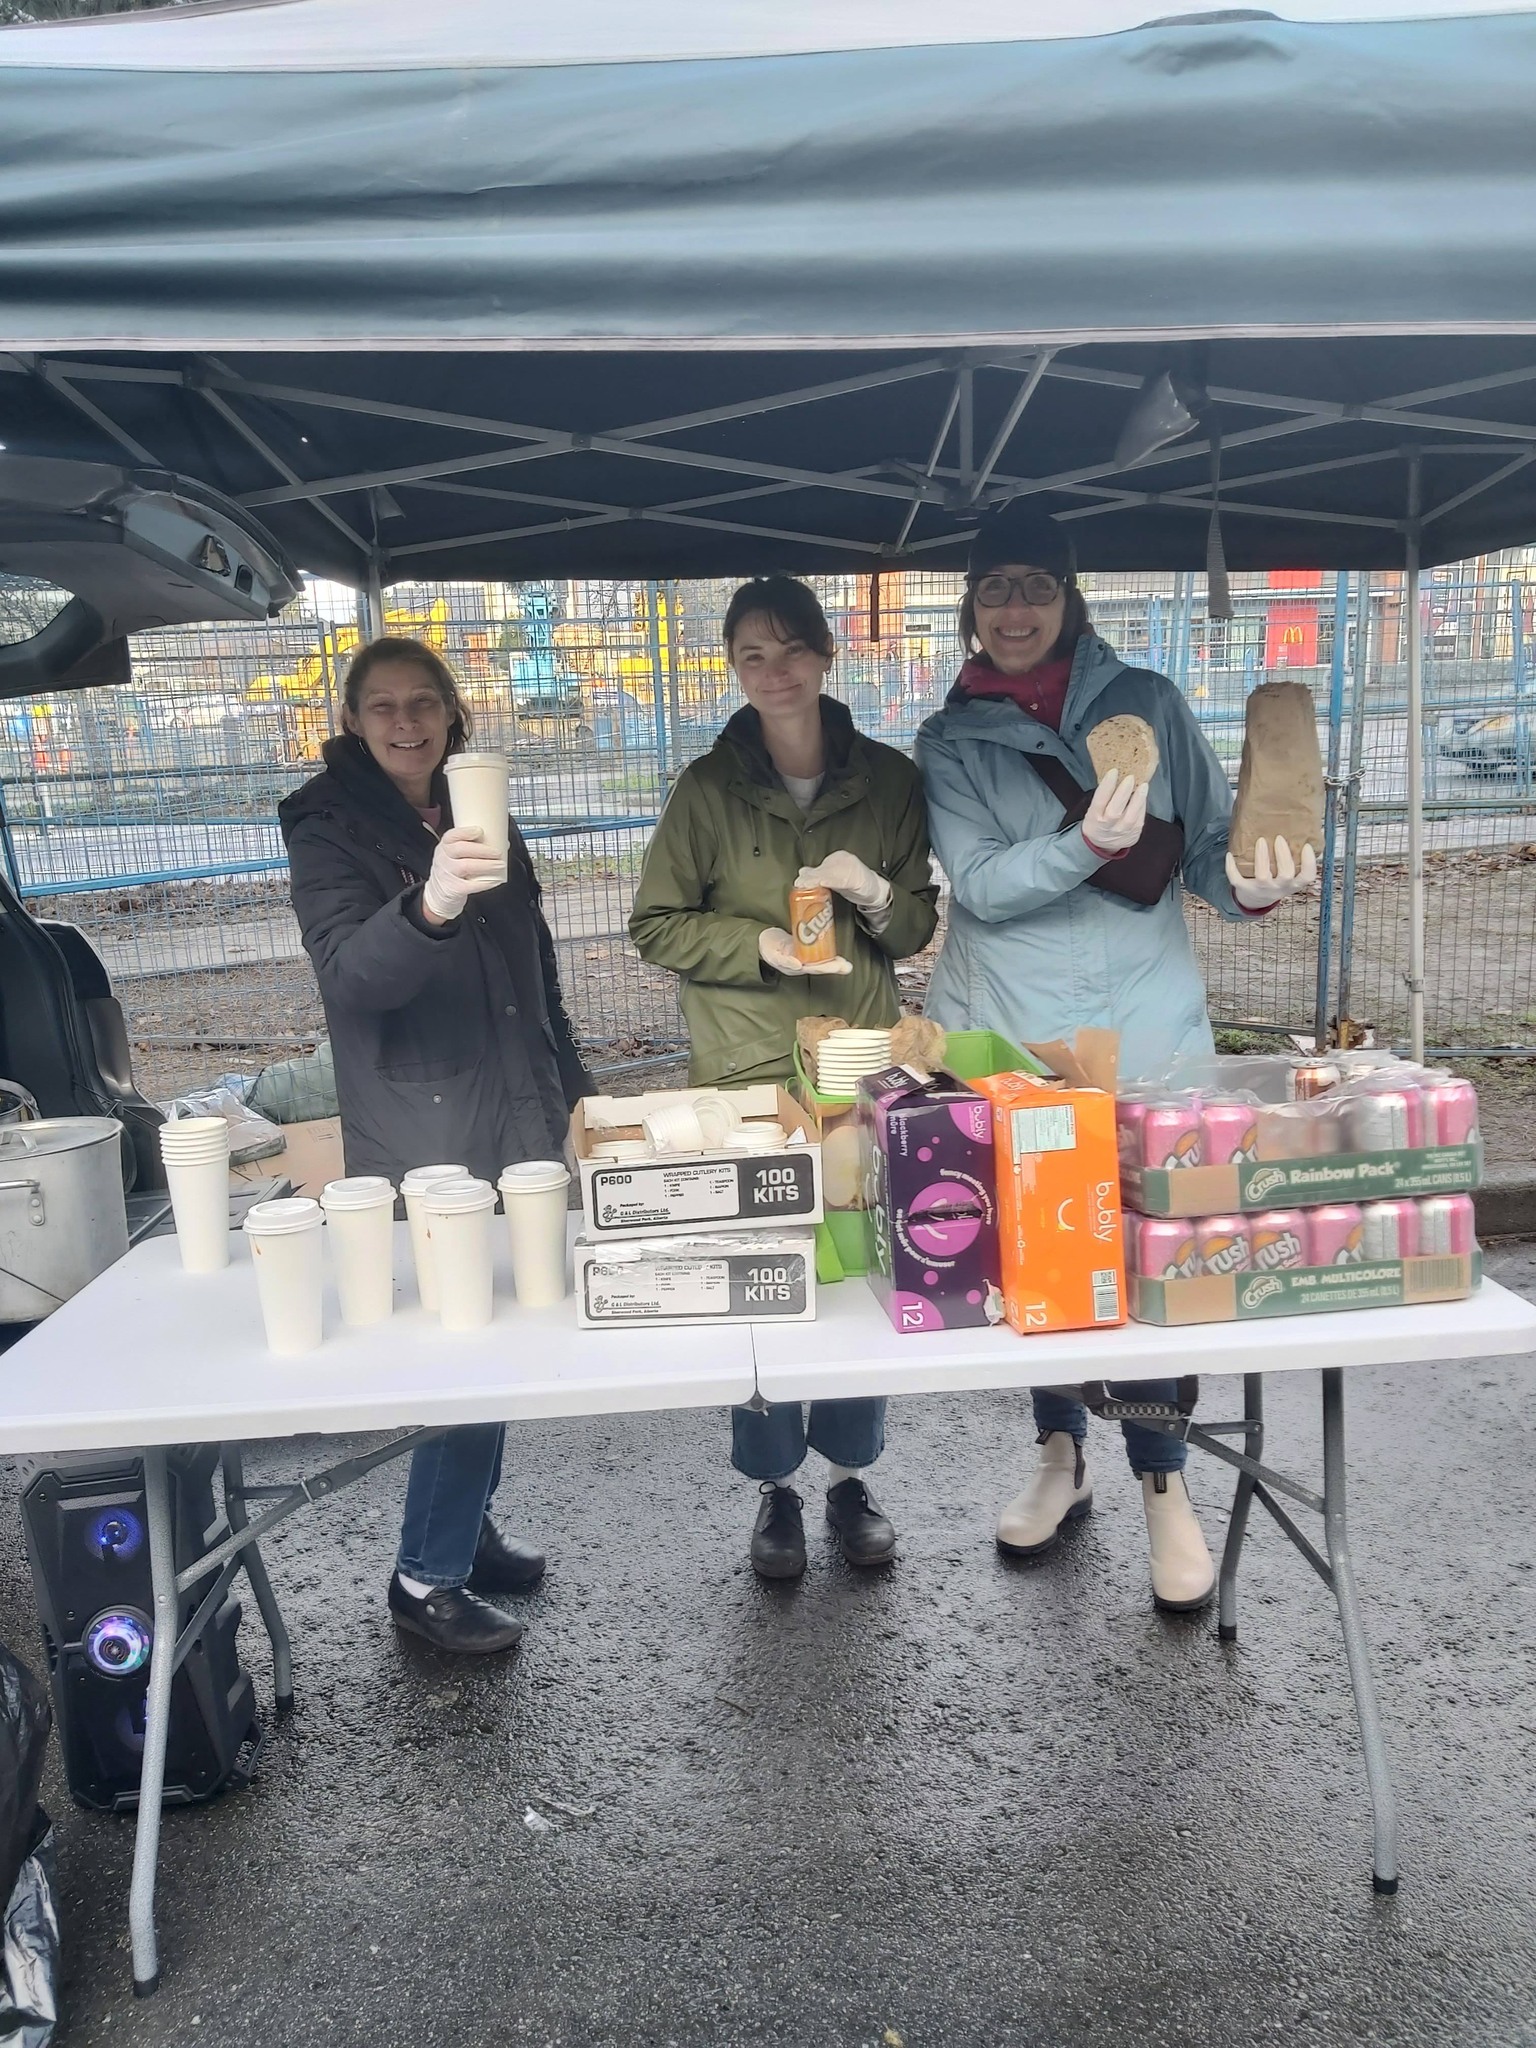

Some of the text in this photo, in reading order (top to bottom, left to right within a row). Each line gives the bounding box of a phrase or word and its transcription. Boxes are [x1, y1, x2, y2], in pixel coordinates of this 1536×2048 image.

[973, 1105, 987, 1139] bubly
[600, 1175, 632, 1186] P600
[663, 1170, 692, 1178] WRAPPED
[692, 1168, 717, 1176] CUTLERY
[755, 1167, 795, 1186] 100
[1290, 1167, 1356, 1184] Rainbow
[1395, 1178, 1403, 1188] 24
[1432, 1173, 1453, 1184] CANS
[961, 1173, 986, 1196] meeting
[1247, 1170, 1284, 1200] Crush
[753, 1185, 800, 1204] KITS
[981, 1192, 991, 1208] you
[872, 1145, 887, 1276] bubly
[985, 1206, 994, 1226] here
[1093, 1181, 1117, 1242] bubly
[1206, 1236, 1250, 1275] rush
[1254, 1232, 1301, 1270] rush
[747, 1267, 787, 1284] 100
[1321, 1267, 1401, 1284] MULTICOLORE
[745, 1284, 791, 1302] KITS
[1243, 1277, 1281, 1308] Crush
[1310, 1290, 1347, 1302] CANETTES
[1347, 1289, 1357, 1299] DE
[902, 1301, 924, 1326] 12
[1024, 1301, 1047, 1326] 12
